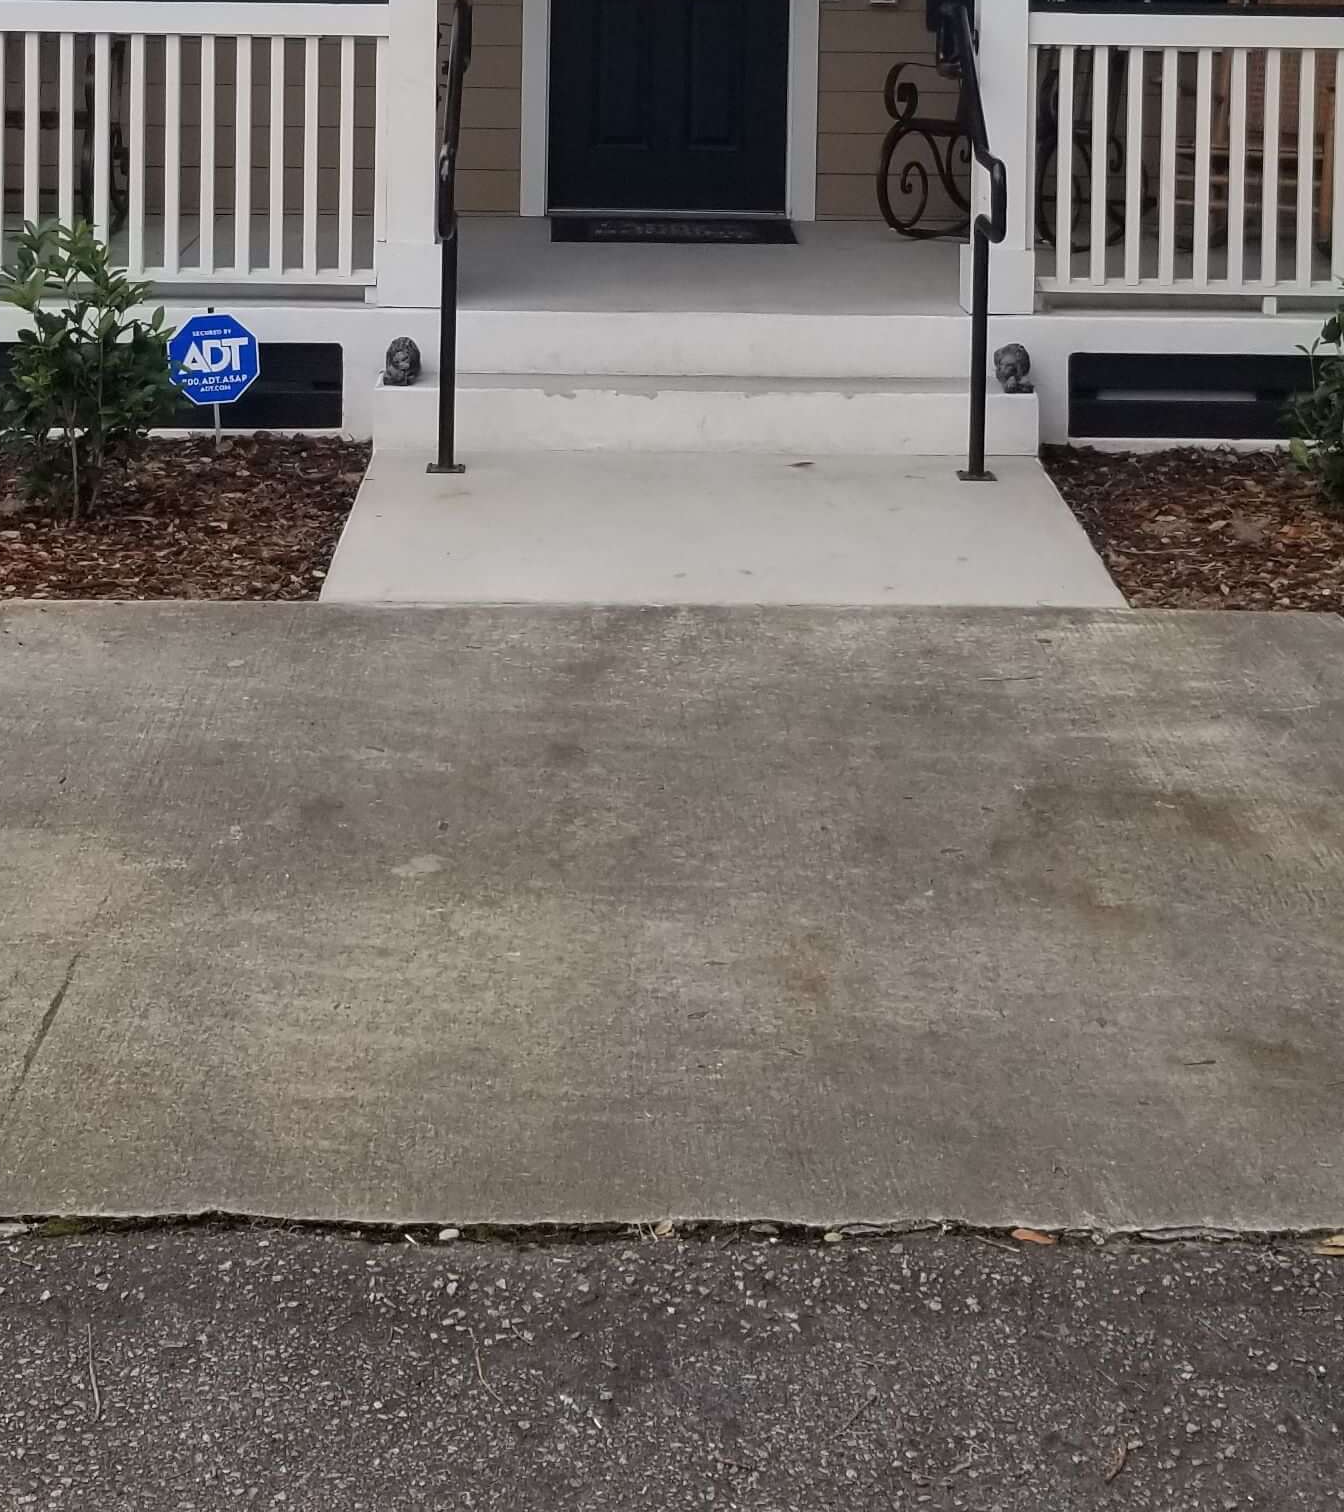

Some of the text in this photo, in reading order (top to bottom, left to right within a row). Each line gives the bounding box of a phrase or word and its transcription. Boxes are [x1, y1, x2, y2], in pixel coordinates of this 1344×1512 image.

[192, 329, 222, 337] SECURED
[179, 337, 248, 374] ADT
[181, 374, 248, 386] 00.ADT.ASAP
